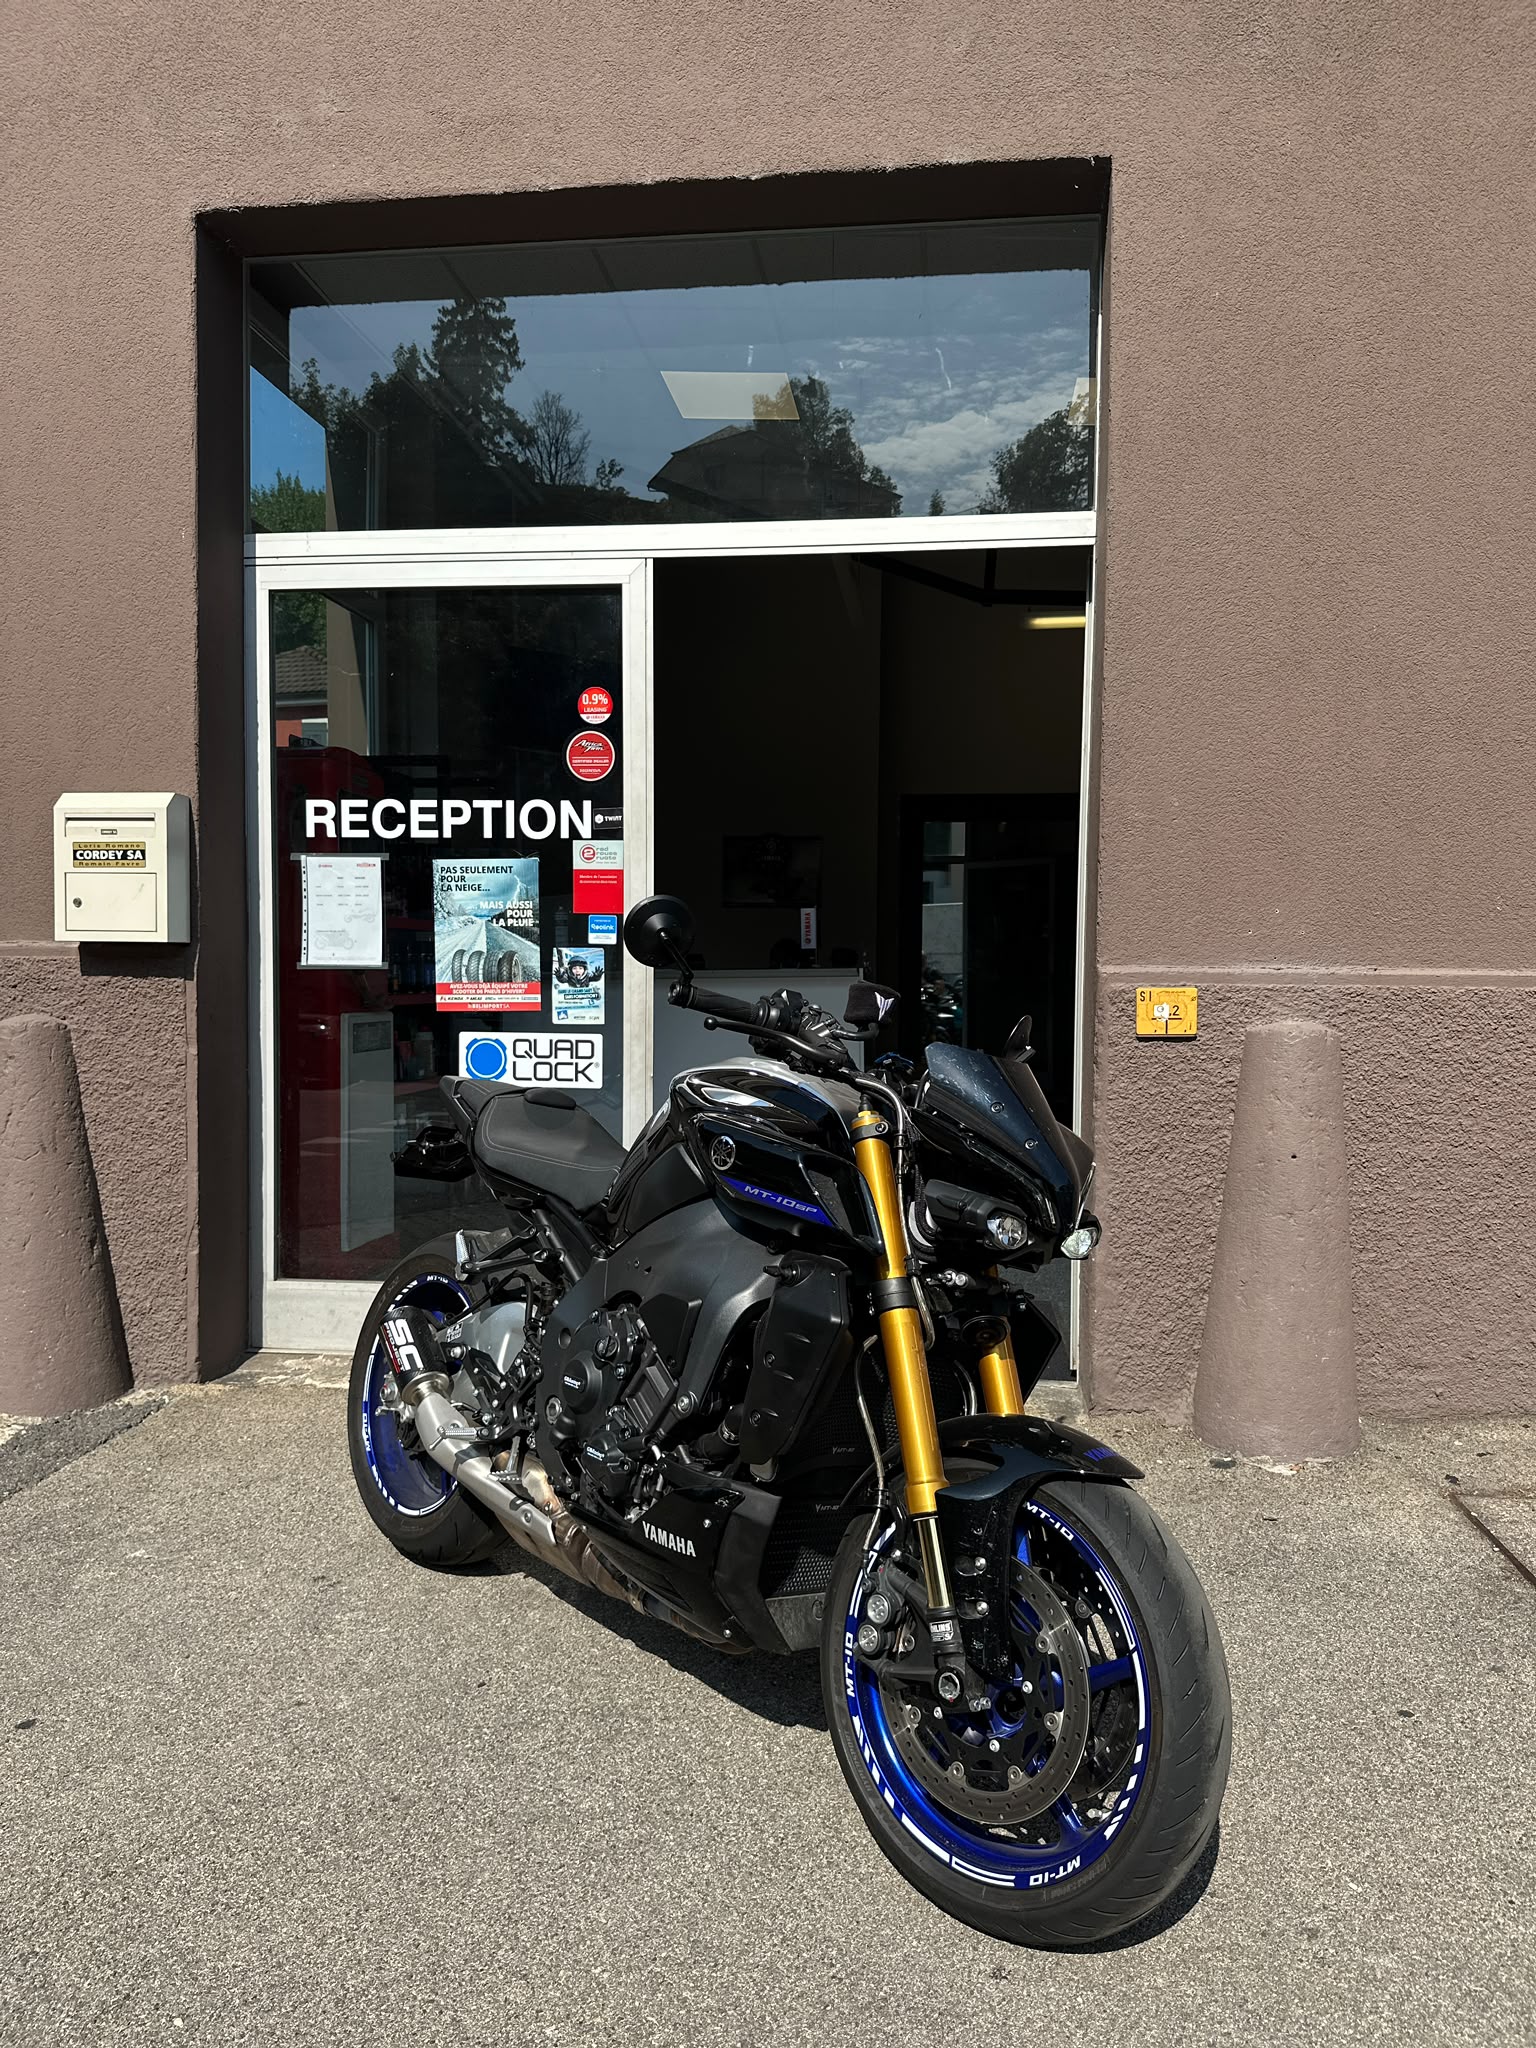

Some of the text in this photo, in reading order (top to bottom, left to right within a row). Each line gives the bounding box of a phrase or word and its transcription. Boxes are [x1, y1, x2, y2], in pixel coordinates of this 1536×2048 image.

[582, 694, 608, 705] 0.9%
[306, 798, 592, 839] RECEPTION
[76, 850, 144, 860] CORDEY SA
[440, 866, 514, 874] PAS SEULEMENT
[440, 875, 467, 883] POUR
[440, 884, 491, 892] LA NEIGE...
[480, 901, 533, 909] MAIS AUSSI
[507, 910, 534, 918] POUR
[493, 919, 534, 927] LA PLUIE
[804, 912, 812, 938] YAMAHA
[512, 1038, 595, 1060] QUAD
[512, 1060, 594, 1082] LOCK
[387, 1318, 425, 1372] SC
[362, 1412, 371, 1452] MT-10
[1022, 1501, 1075, 1541] MT-10
[642, 1520, 697, 1558] YAMAHA
[844, 1631, 856, 1698] MT-10
[1029, 1855, 1081, 1887] MT-10
